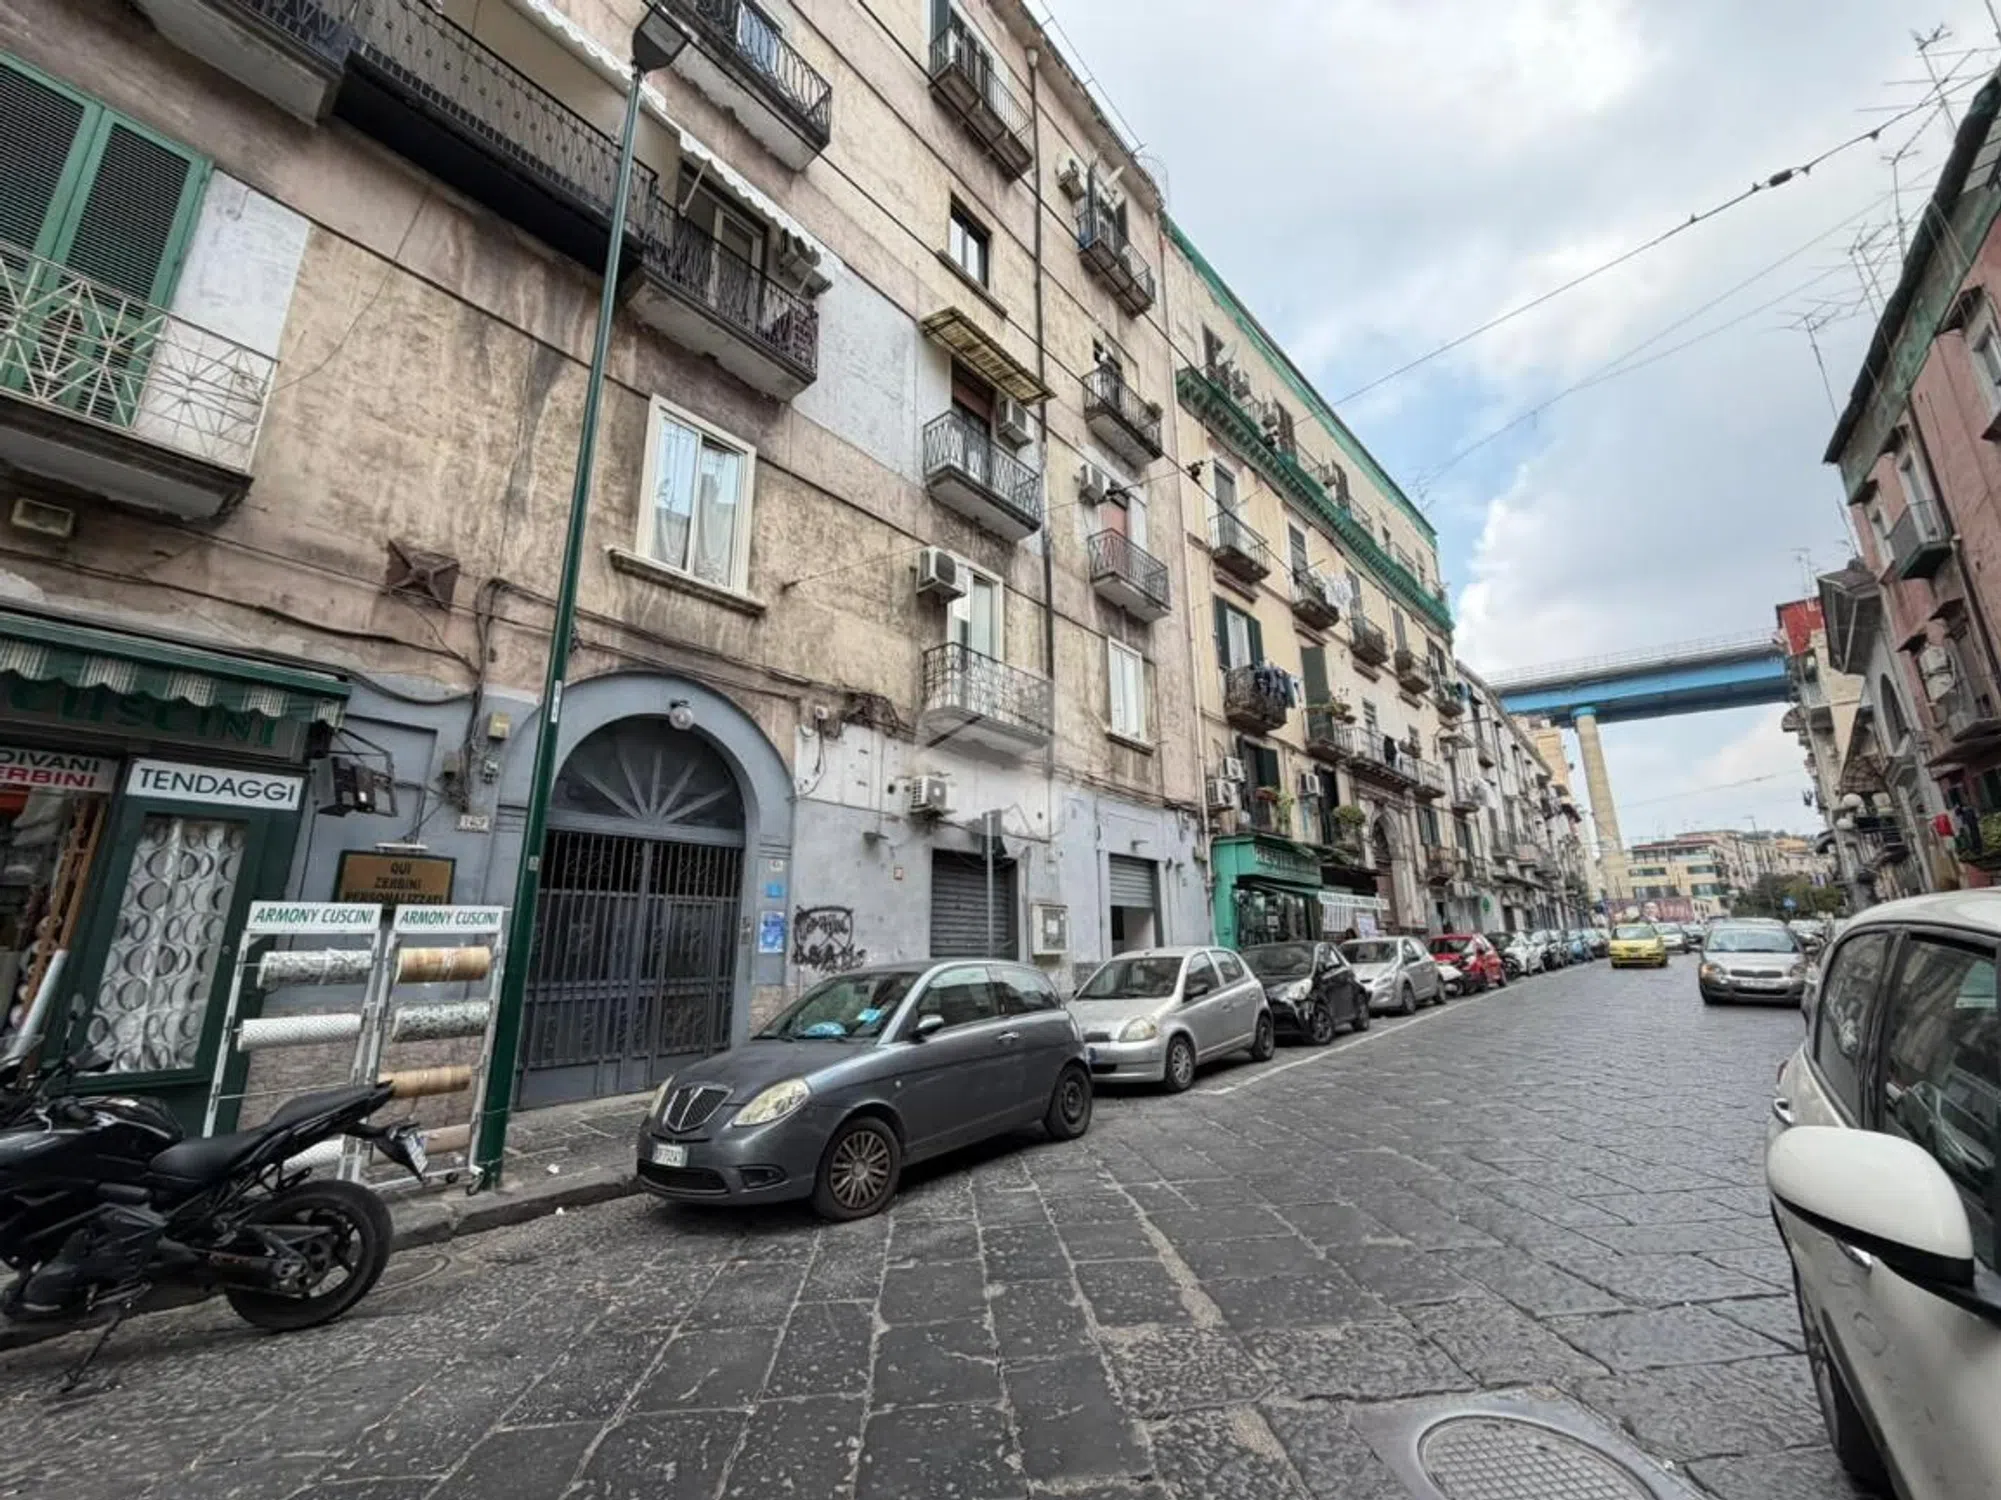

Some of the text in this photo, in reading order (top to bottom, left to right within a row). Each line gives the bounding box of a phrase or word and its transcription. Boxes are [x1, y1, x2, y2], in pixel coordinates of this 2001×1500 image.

[139, 767, 296, 803] TENDAGGI
[390, 860, 412, 875] QUI
[254, 908, 374, 925] ARMONY CUSCINI
[400, 910, 499, 926] ARMONY CUSCINI
